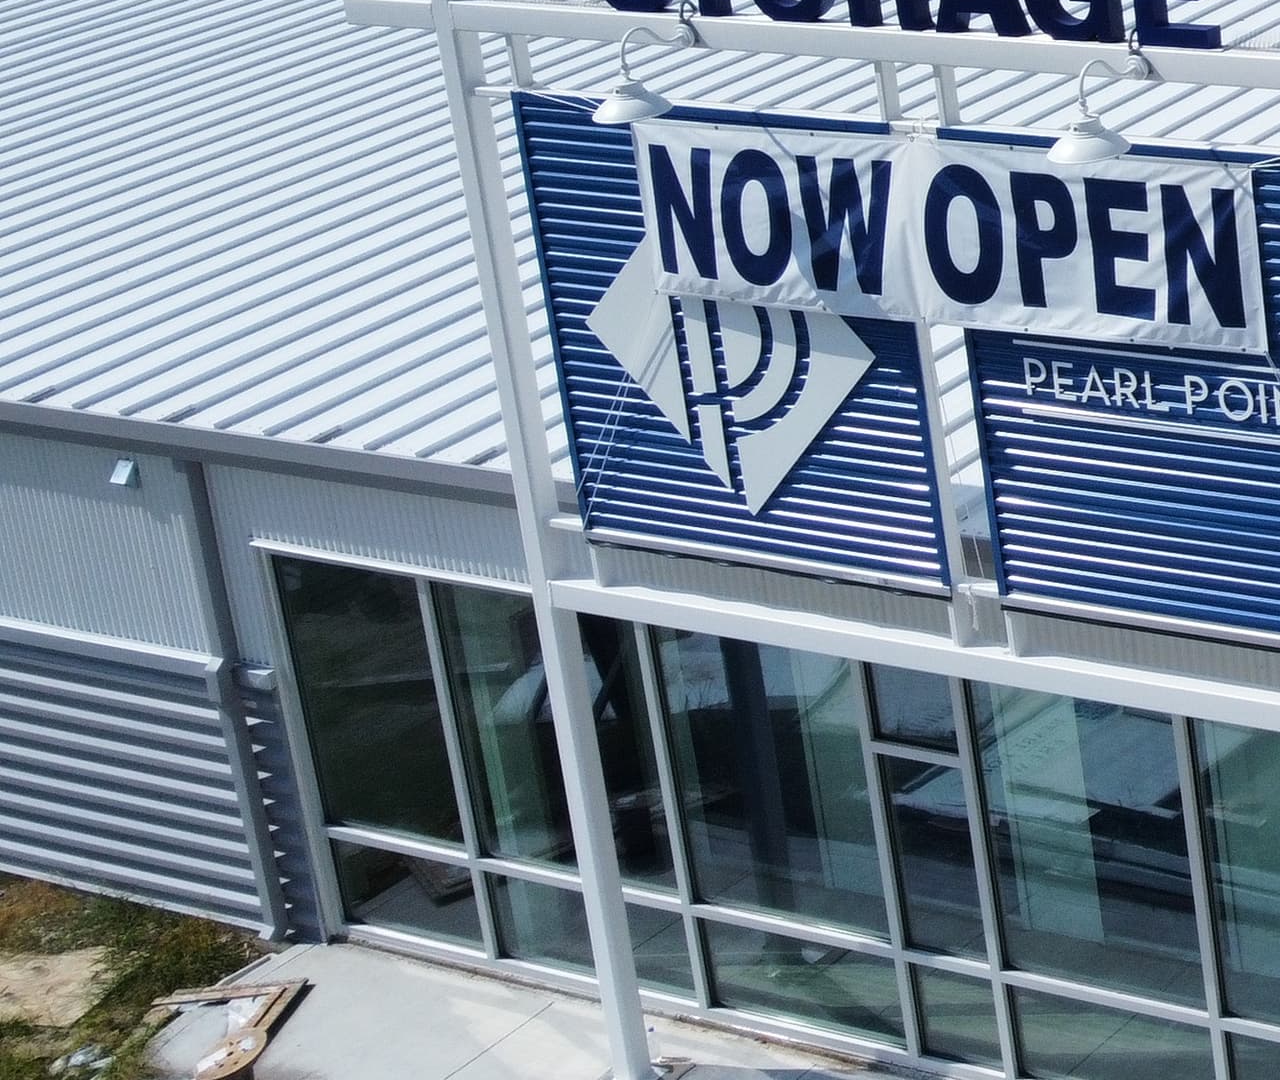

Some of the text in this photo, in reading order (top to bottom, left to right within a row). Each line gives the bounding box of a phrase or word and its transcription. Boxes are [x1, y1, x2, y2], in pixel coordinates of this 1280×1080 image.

[648, 144, 1247, 329] NOW OPEN
[1022, 357, 1169, 413] PEARL
